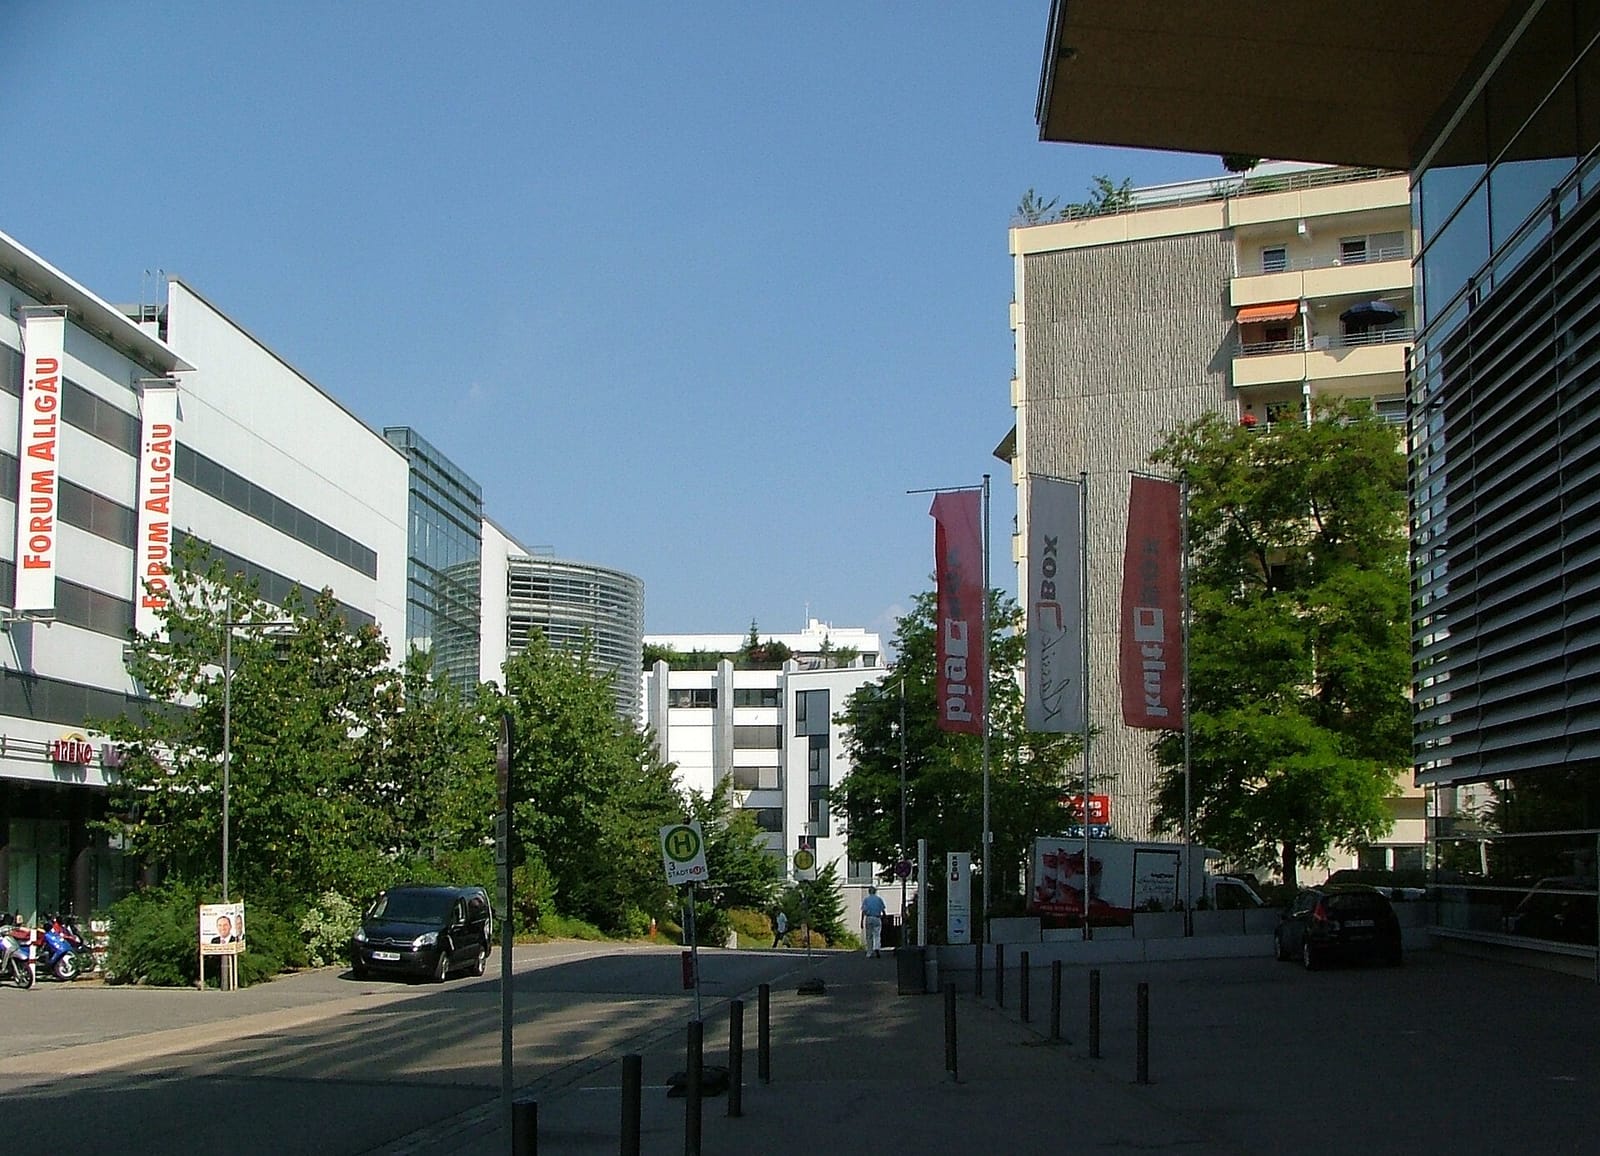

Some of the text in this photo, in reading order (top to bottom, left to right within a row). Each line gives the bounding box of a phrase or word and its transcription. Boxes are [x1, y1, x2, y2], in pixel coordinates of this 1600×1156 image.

[24, 357, 60, 569] FORUM ALLGÄU
[142, 423, 173, 609] FORUM ALLGÄU
[669, 861, 676, 871] 3
[674, 833, 691, 854] H
